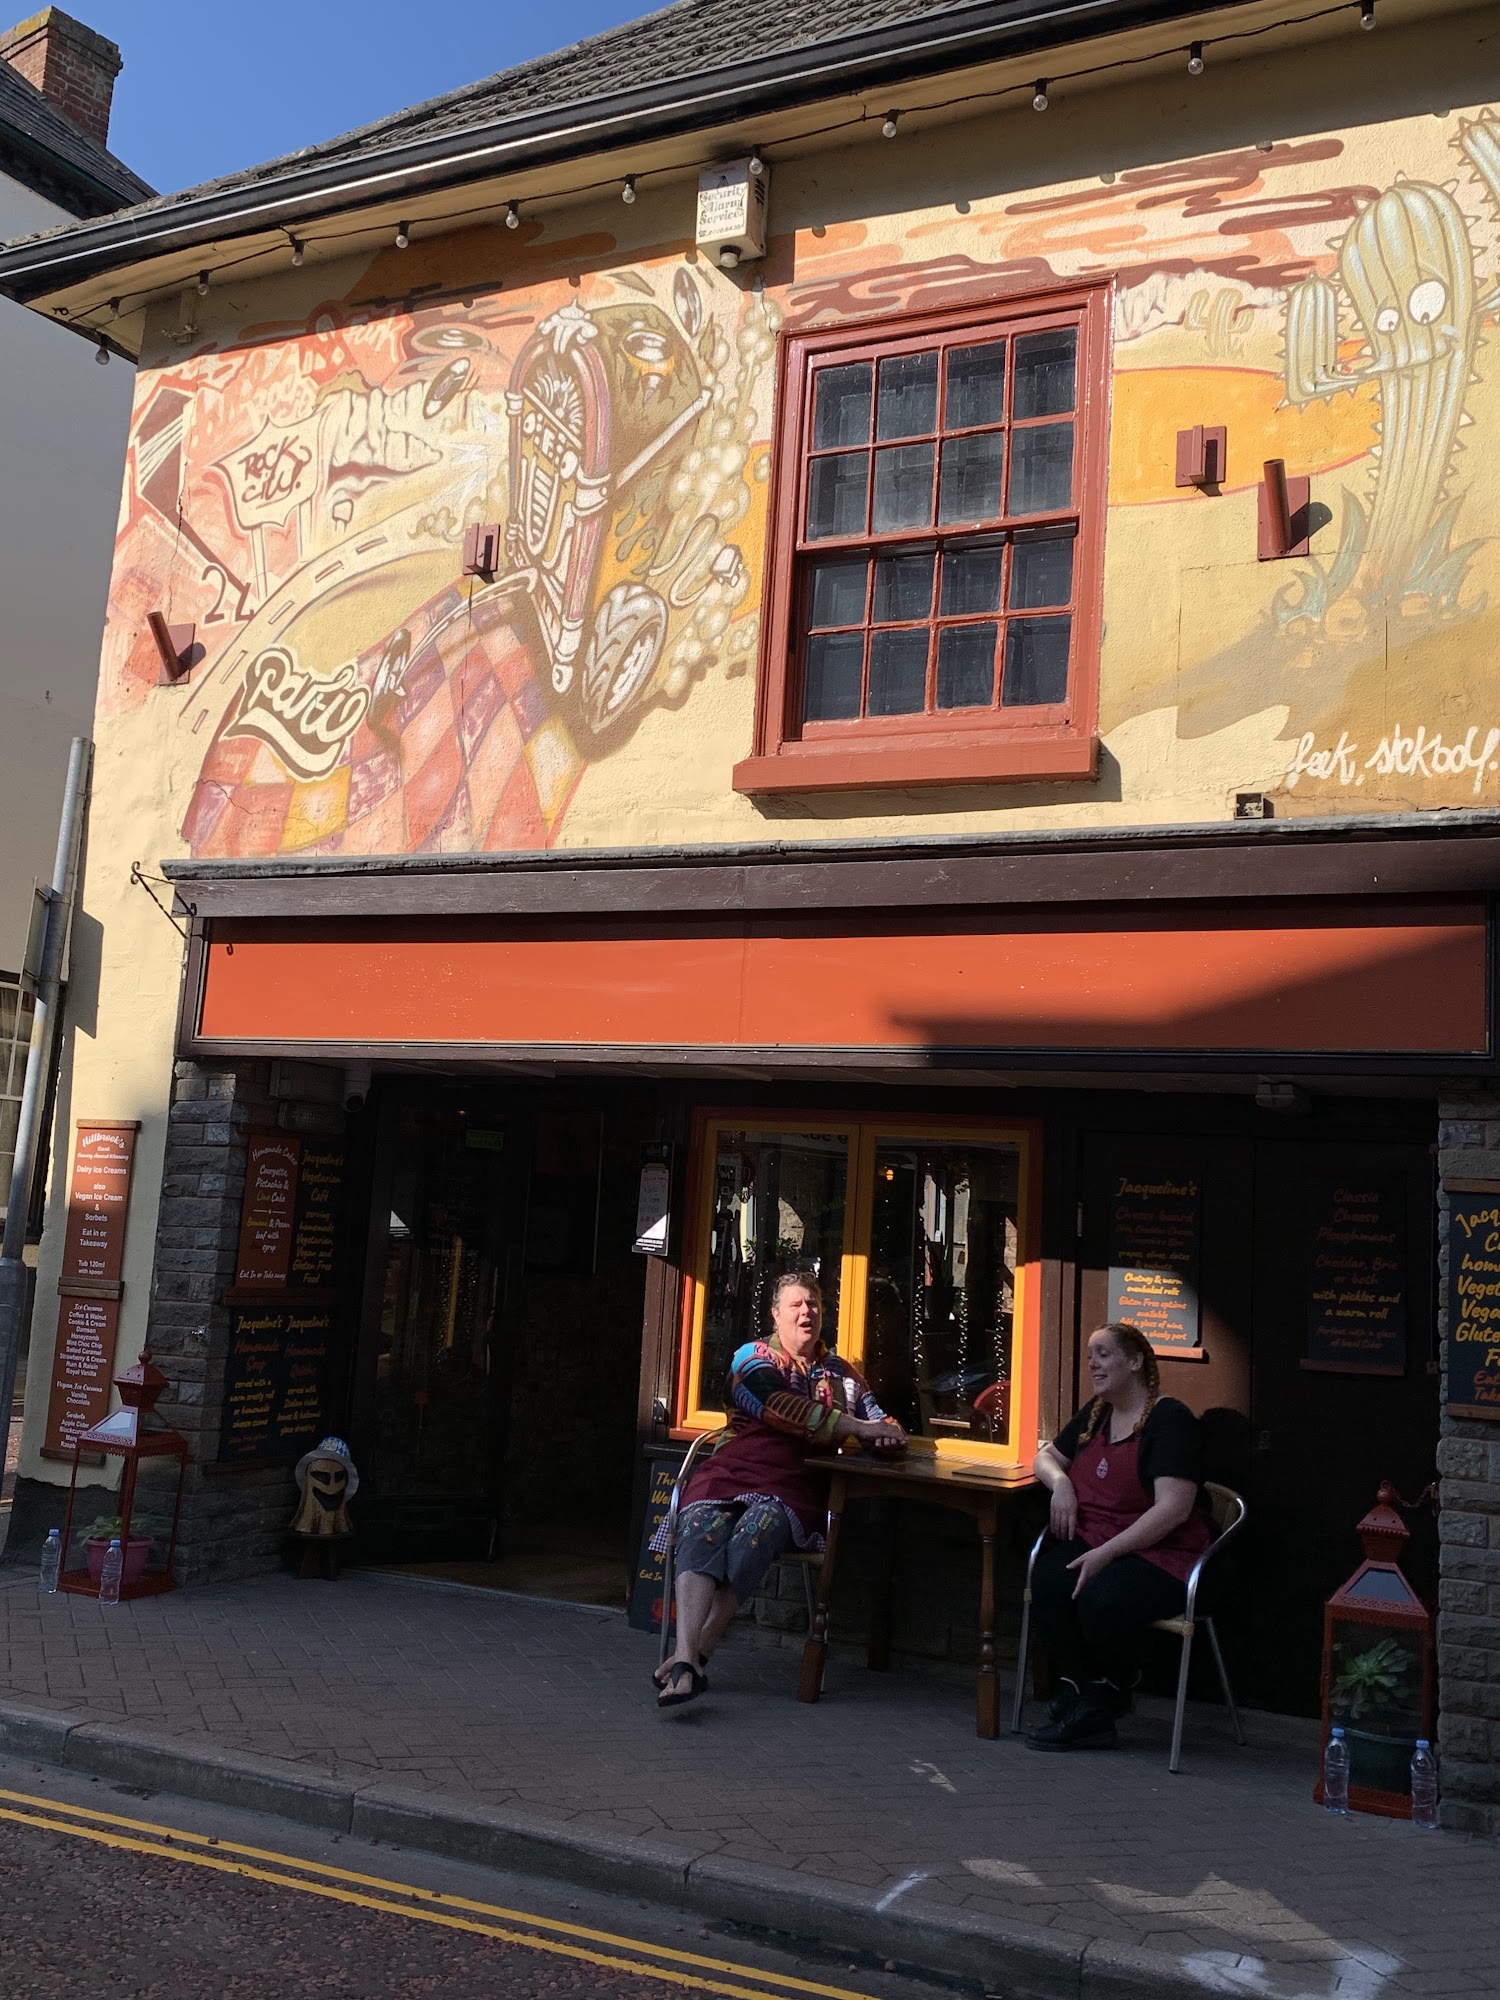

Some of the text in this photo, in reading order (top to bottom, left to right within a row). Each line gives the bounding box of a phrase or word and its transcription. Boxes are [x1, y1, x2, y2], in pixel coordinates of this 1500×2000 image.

[699, 184, 747, 203] Security
[82, 1132, 125, 1148] Hillbrook's
[76, 1165, 92, 1174] Dairy
[103, 1166, 126, 1174] Creams
[255, 1177, 290, 1191] Pistachio &
[1115, 1177, 1198, 1200] Jacqueline's
[75, 1192, 93, 1201] Vegan
[103, 1193, 123, 1201] Cream
[271, 1191, 286, 1203] Cake
[94, 1203, 100, 1211] &
[84, 1213, 108, 1222] Sorbets
[268, 1219, 275, 1228] &
[1455, 1208, 1500, 1238] Jacq
[82, 1228, 92, 1236] Eat
[267, 1231, 280, 1240] with
[80, 1238, 108, 1249] Takeaway
[262, 1244, 277, 1253] syrup
[78, 1259, 88, 1267] Tub
[1461, 1253, 1500, 1273] hom
[239, 1270, 250, 1278] Eat
[1153, 1274, 1163, 1284] &
[1163, 1287, 1180, 1296] rolls
[1457, 1274, 1500, 1300] Veget
[1312, 1289, 1401, 1304] with pickles and
[1118, 1295, 1187, 1310] Gluten Free options
[1136, 1310, 1169, 1319] available
[1368, 1307, 1389, 1320] roll
[1461, 1298, 1500, 1324] Vega
[68, 1311, 84, 1319] Coffee
[90, 1313, 107, 1321] Walnut
[235, 1314, 283, 1334] Jacqueline's
[285, 1313, 330, 1334] Jacqueline's
[1140, 1319, 1158, 1328] glass
[1158, 1320, 1167, 1328] of
[70, 1333, 99, 1341] Honeycomb
[1171, 1332, 1187, 1341] port
[1455, 1322, 1500, 1343] Glute
[91, 1341, 103, 1349] Chip
[66, 1346, 81, 1354] Salted
[59, 1352, 85, 1362] Strawberry
[83, 1362, 99, 1370] Raisin
[66, 1367, 97, 1377] Royal Vanilla
[71, 1391, 87, 1399] Vanilla
[66, 1396, 90, 1406] Chocolate
[61, 1419, 89, 1428] Apple Cider
[65, 1434, 77, 1443] Mang
[61, 1441, 76, 1449] Raspb
[651, 1489, 671, 1505] We
